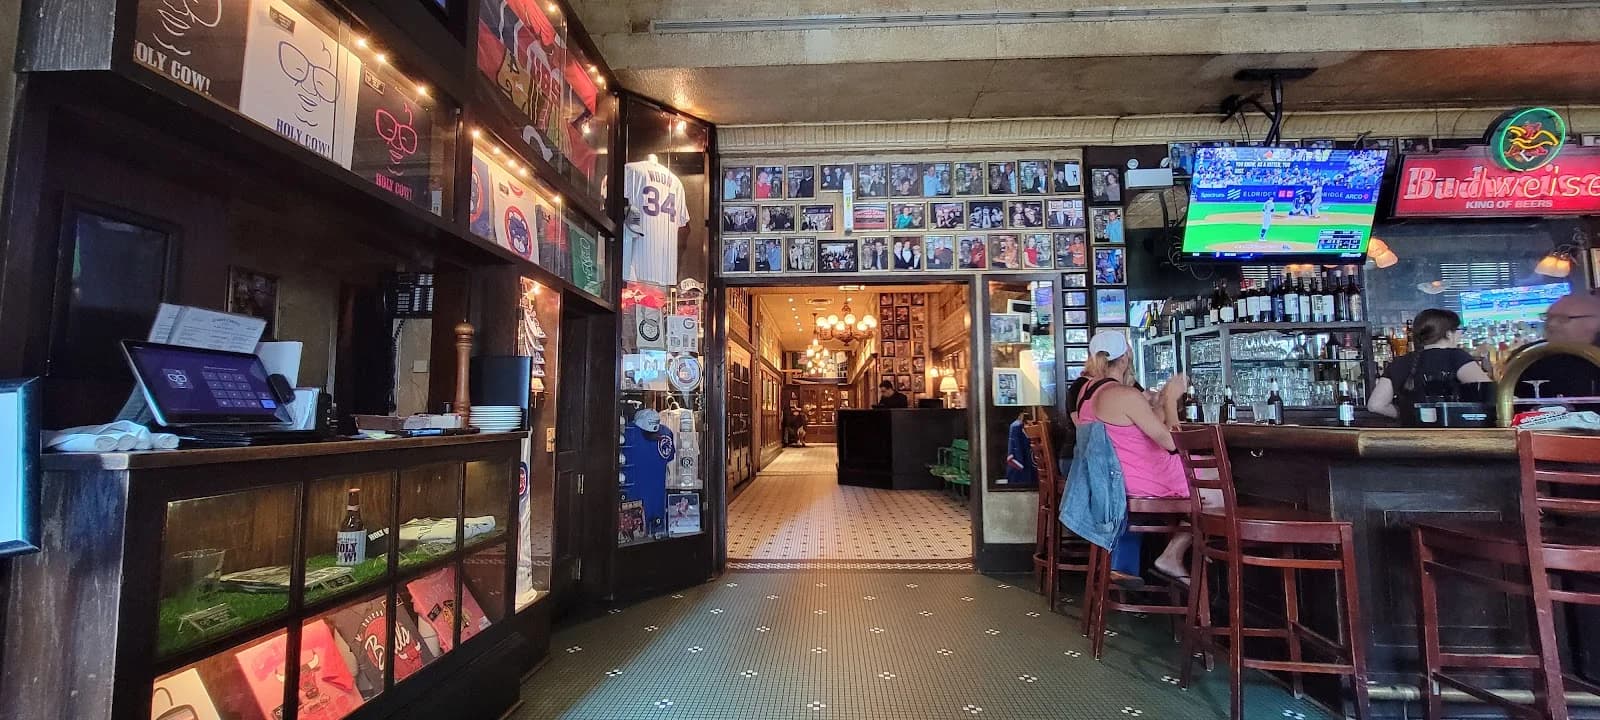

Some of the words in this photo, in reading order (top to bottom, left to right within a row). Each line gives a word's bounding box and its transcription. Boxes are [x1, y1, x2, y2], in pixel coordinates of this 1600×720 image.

[171, 60, 211, 95] COW!
[276, 118, 303, 142] HOLY
[305, 134, 330, 158] COW!
[375, 172, 394, 192] HOLY
[642, 185, 677, 223] 34
[1465, 200, 1495, 209] KING
[1496, 200, 1513, 209] OF
[1514, 199, 1553, 208] BEERS
